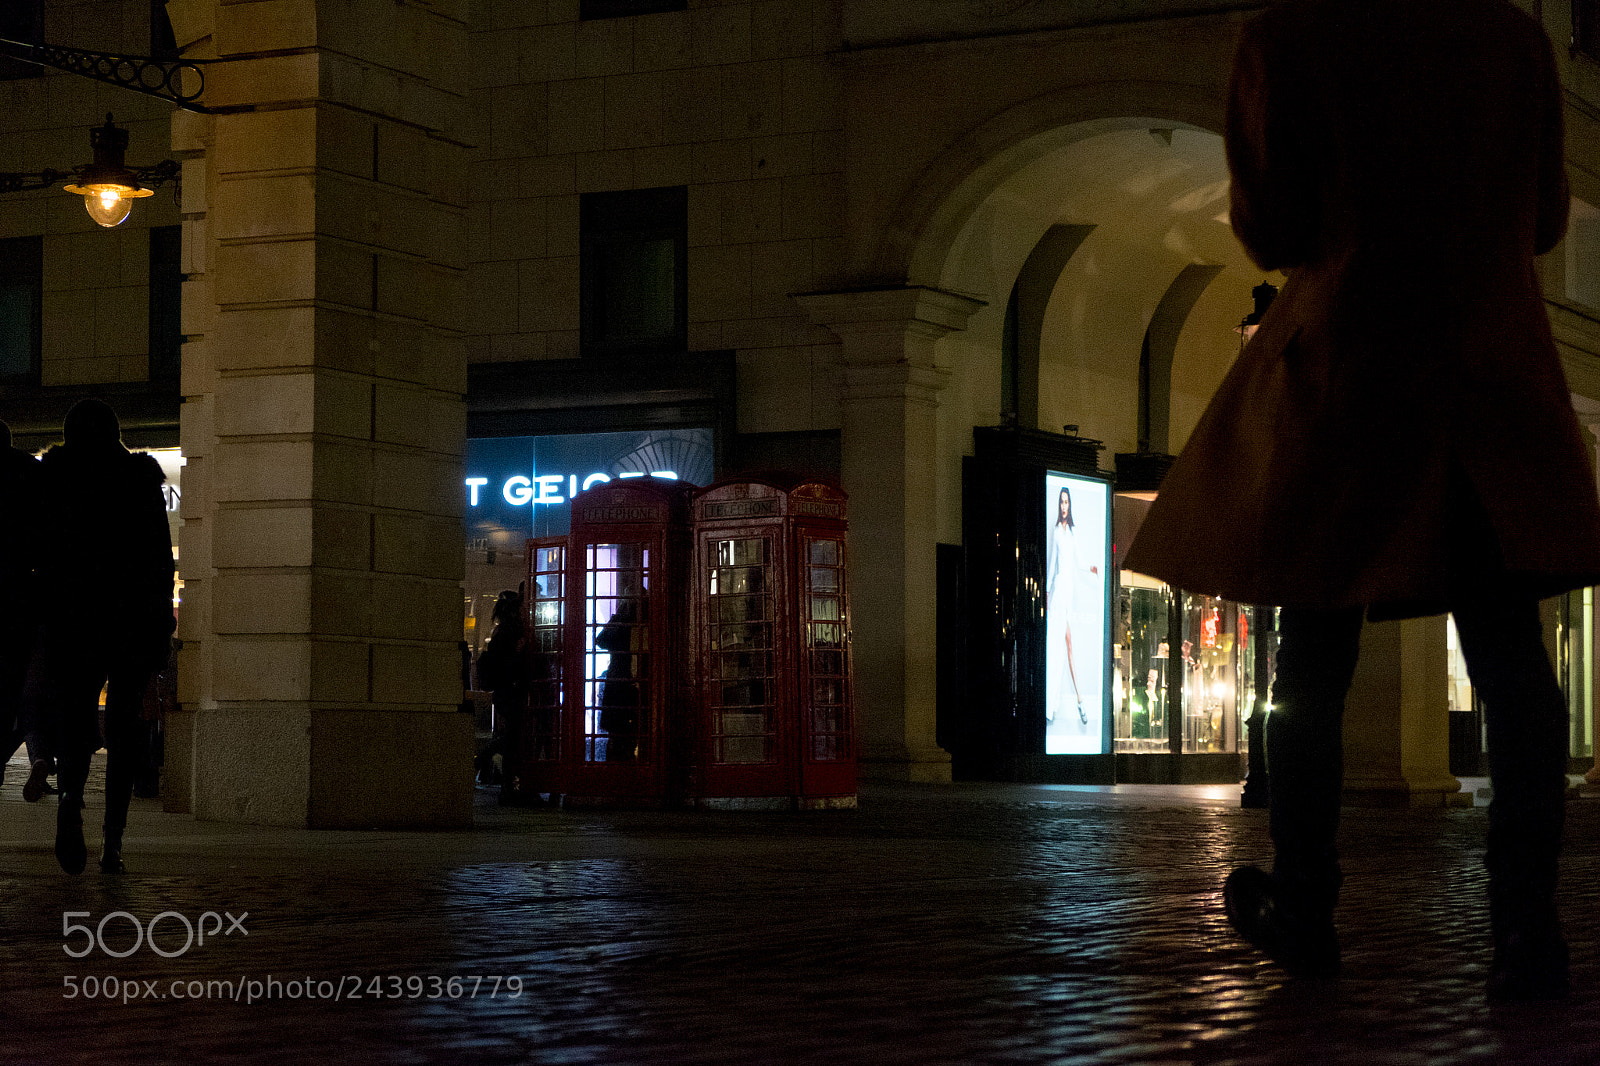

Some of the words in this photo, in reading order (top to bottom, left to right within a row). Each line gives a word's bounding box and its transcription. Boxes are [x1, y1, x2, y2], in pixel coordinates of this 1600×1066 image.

[586, 507, 655, 520] TELEPHONE
[709, 501, 775, 517] TELEPHONE
[796, 501, 838, 516] TELEPHONE
